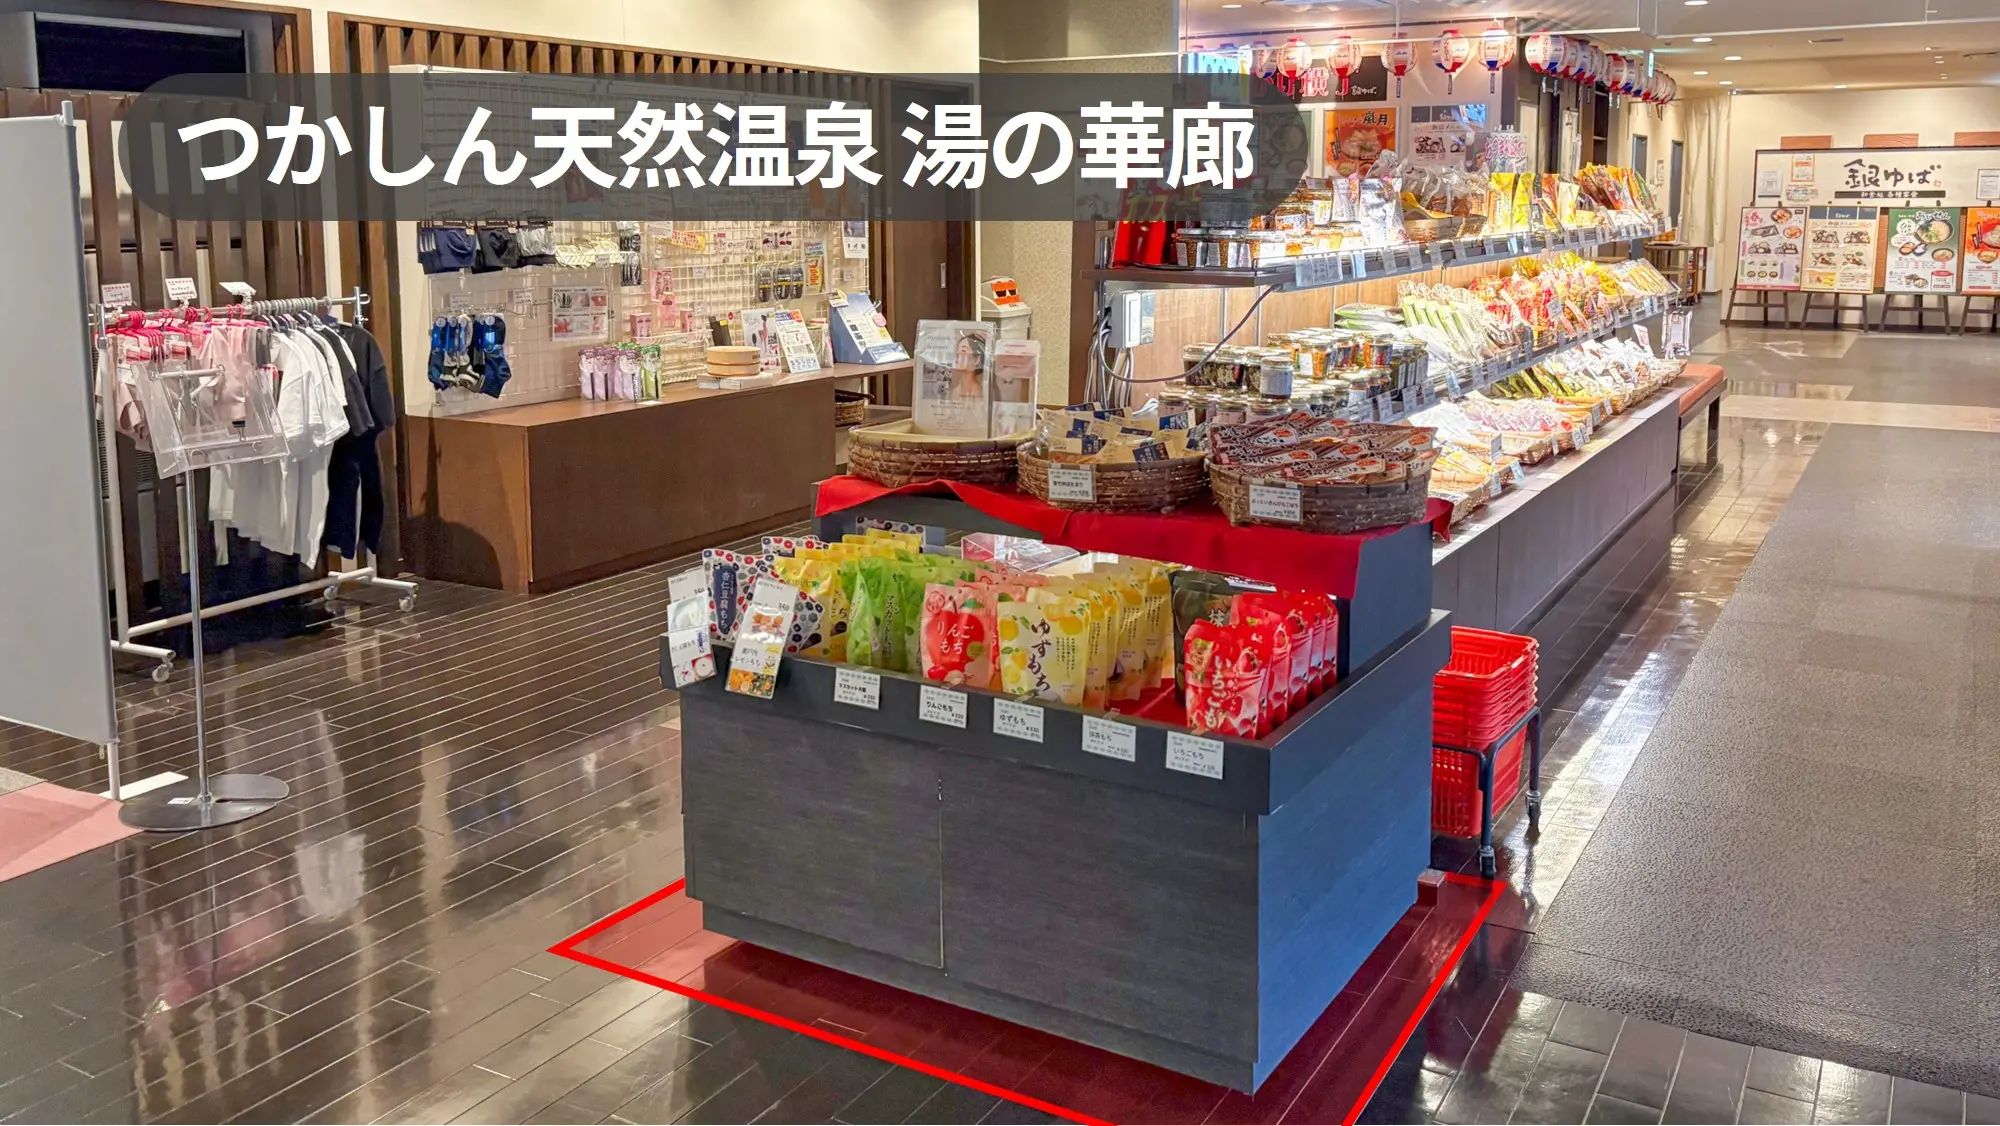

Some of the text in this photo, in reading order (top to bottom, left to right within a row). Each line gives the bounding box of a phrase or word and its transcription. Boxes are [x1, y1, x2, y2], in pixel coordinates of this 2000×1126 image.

[1843, 158, 1942, 188] 銀ゆば
[719, 571, 730, 629] 杏仁豆腐もち
[935, 621, 975, 640] りんご
[939, 640, 964, 656] もち
[1027, 618, 1053, 692] ゆずもち
[926, 700, 953, 712] りんごもち
[999, 714, 1026, 726] ゆずもち
[1173, 747, 1204, 760] いちごもち
